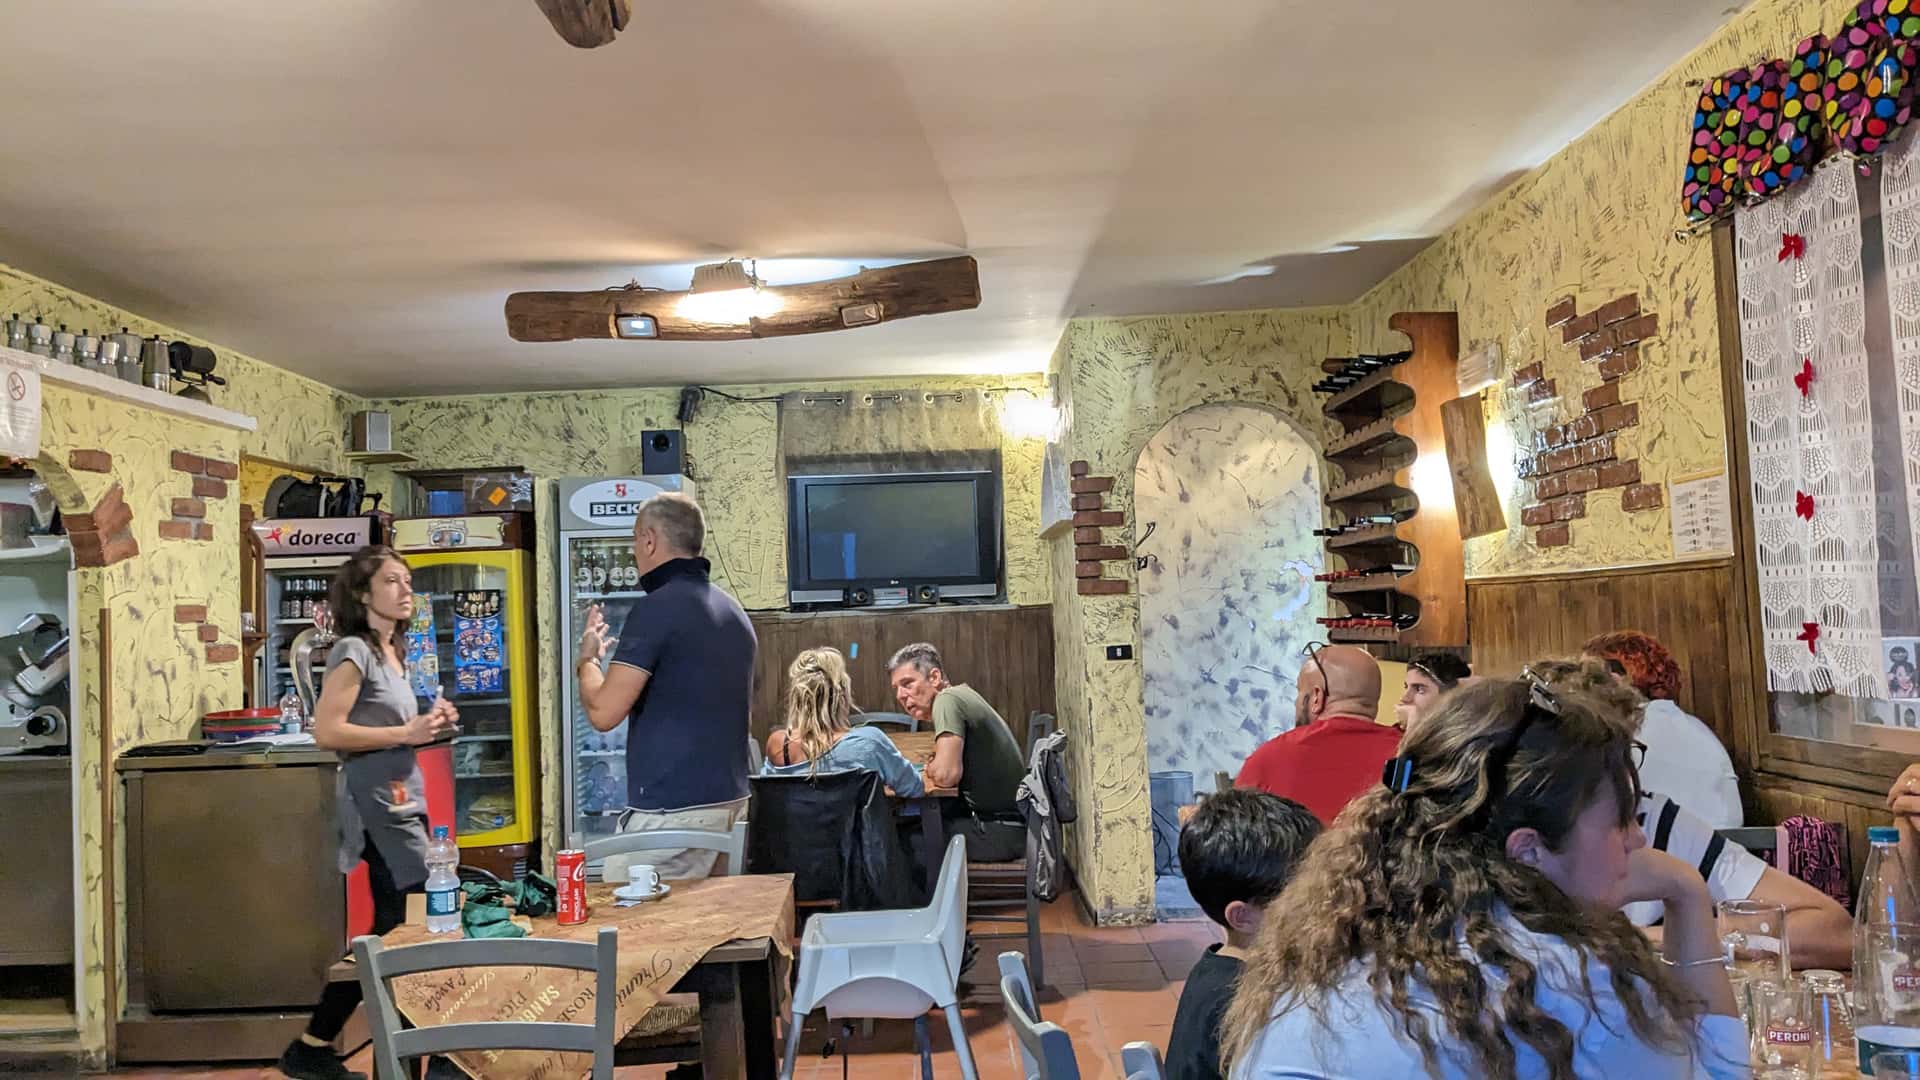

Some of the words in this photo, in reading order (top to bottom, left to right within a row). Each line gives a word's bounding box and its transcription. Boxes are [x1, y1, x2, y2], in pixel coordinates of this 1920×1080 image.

[289, 529, 356, 546] doreca
[615, 950, 673, 1009] Trami
[519, 985, 560, 1022] SANG
[1769, 1031, 1810, 1042] PERONI
